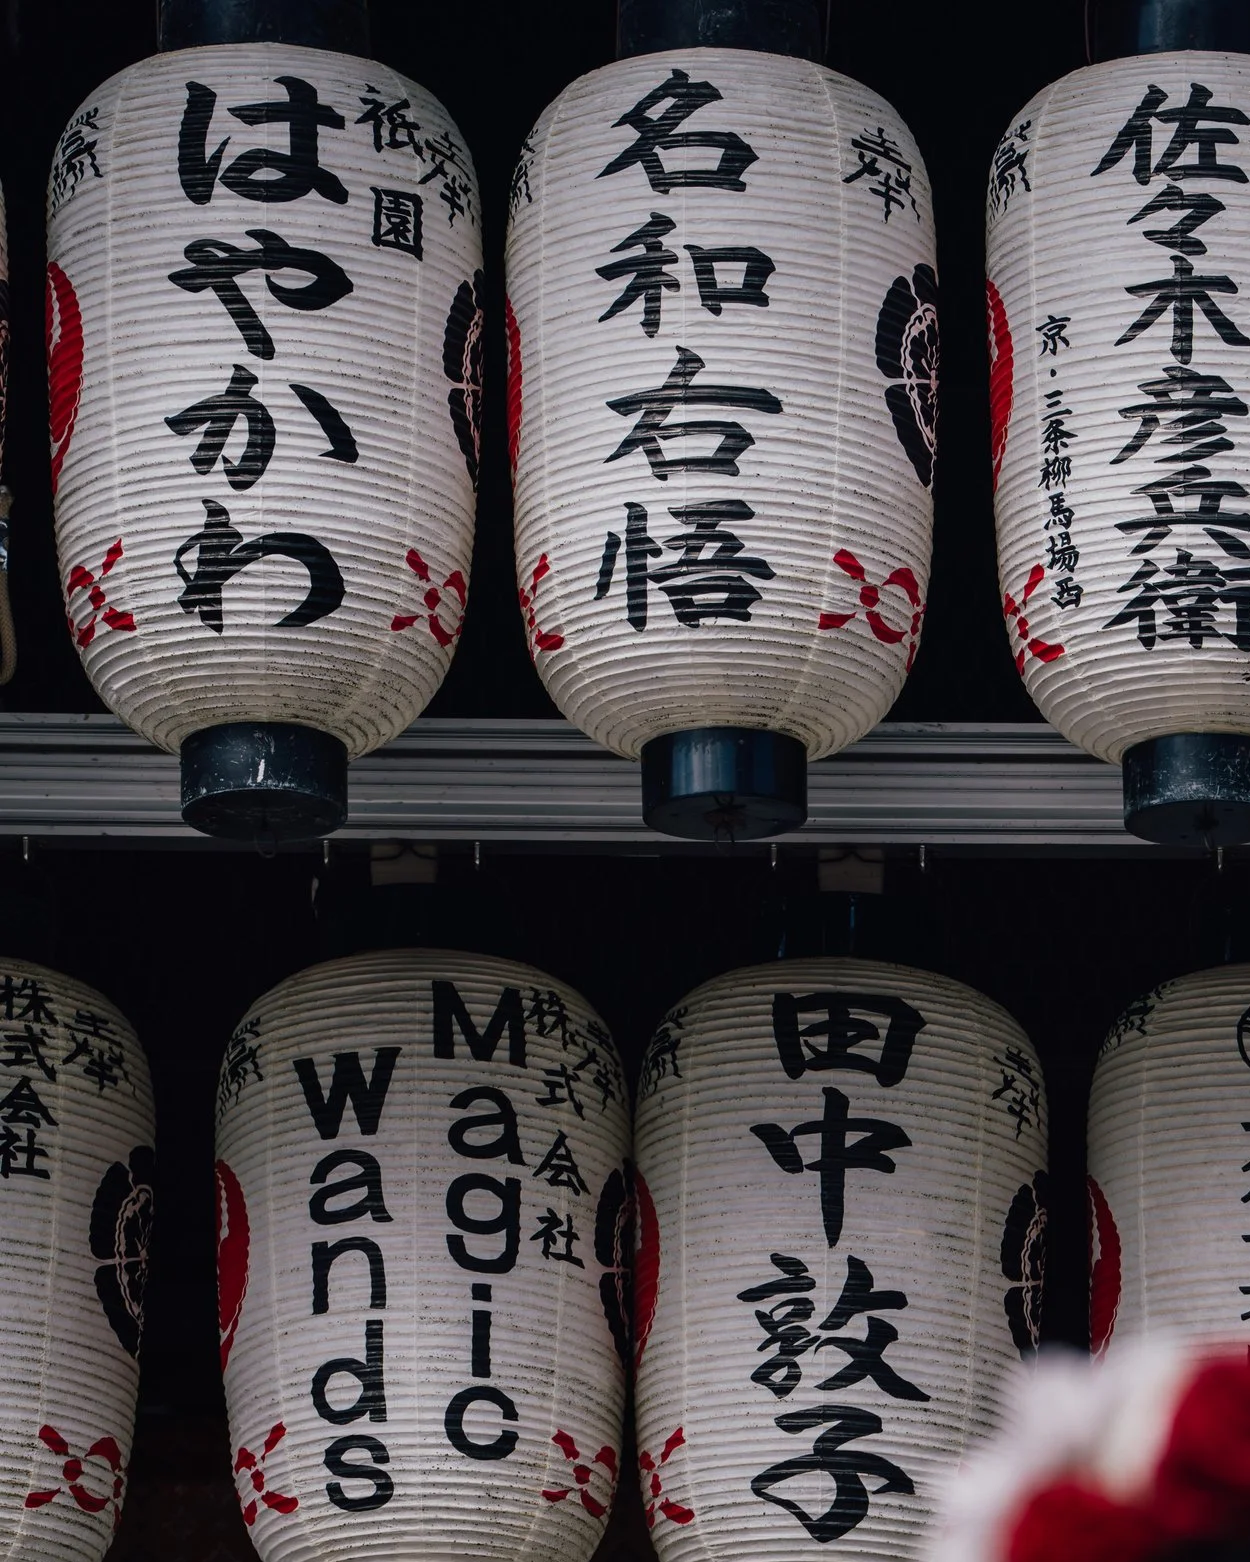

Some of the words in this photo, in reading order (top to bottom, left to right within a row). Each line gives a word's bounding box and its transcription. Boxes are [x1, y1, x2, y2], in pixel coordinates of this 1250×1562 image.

[164, 75, 359, 634] はやかわ
[593, 68, 784, 632] 名和右悟
[432, 980, 528, 1462] Magic
[526, 986, 593, 1270] 株式会社
[737, 991, 931, 1544] 田中敦子
